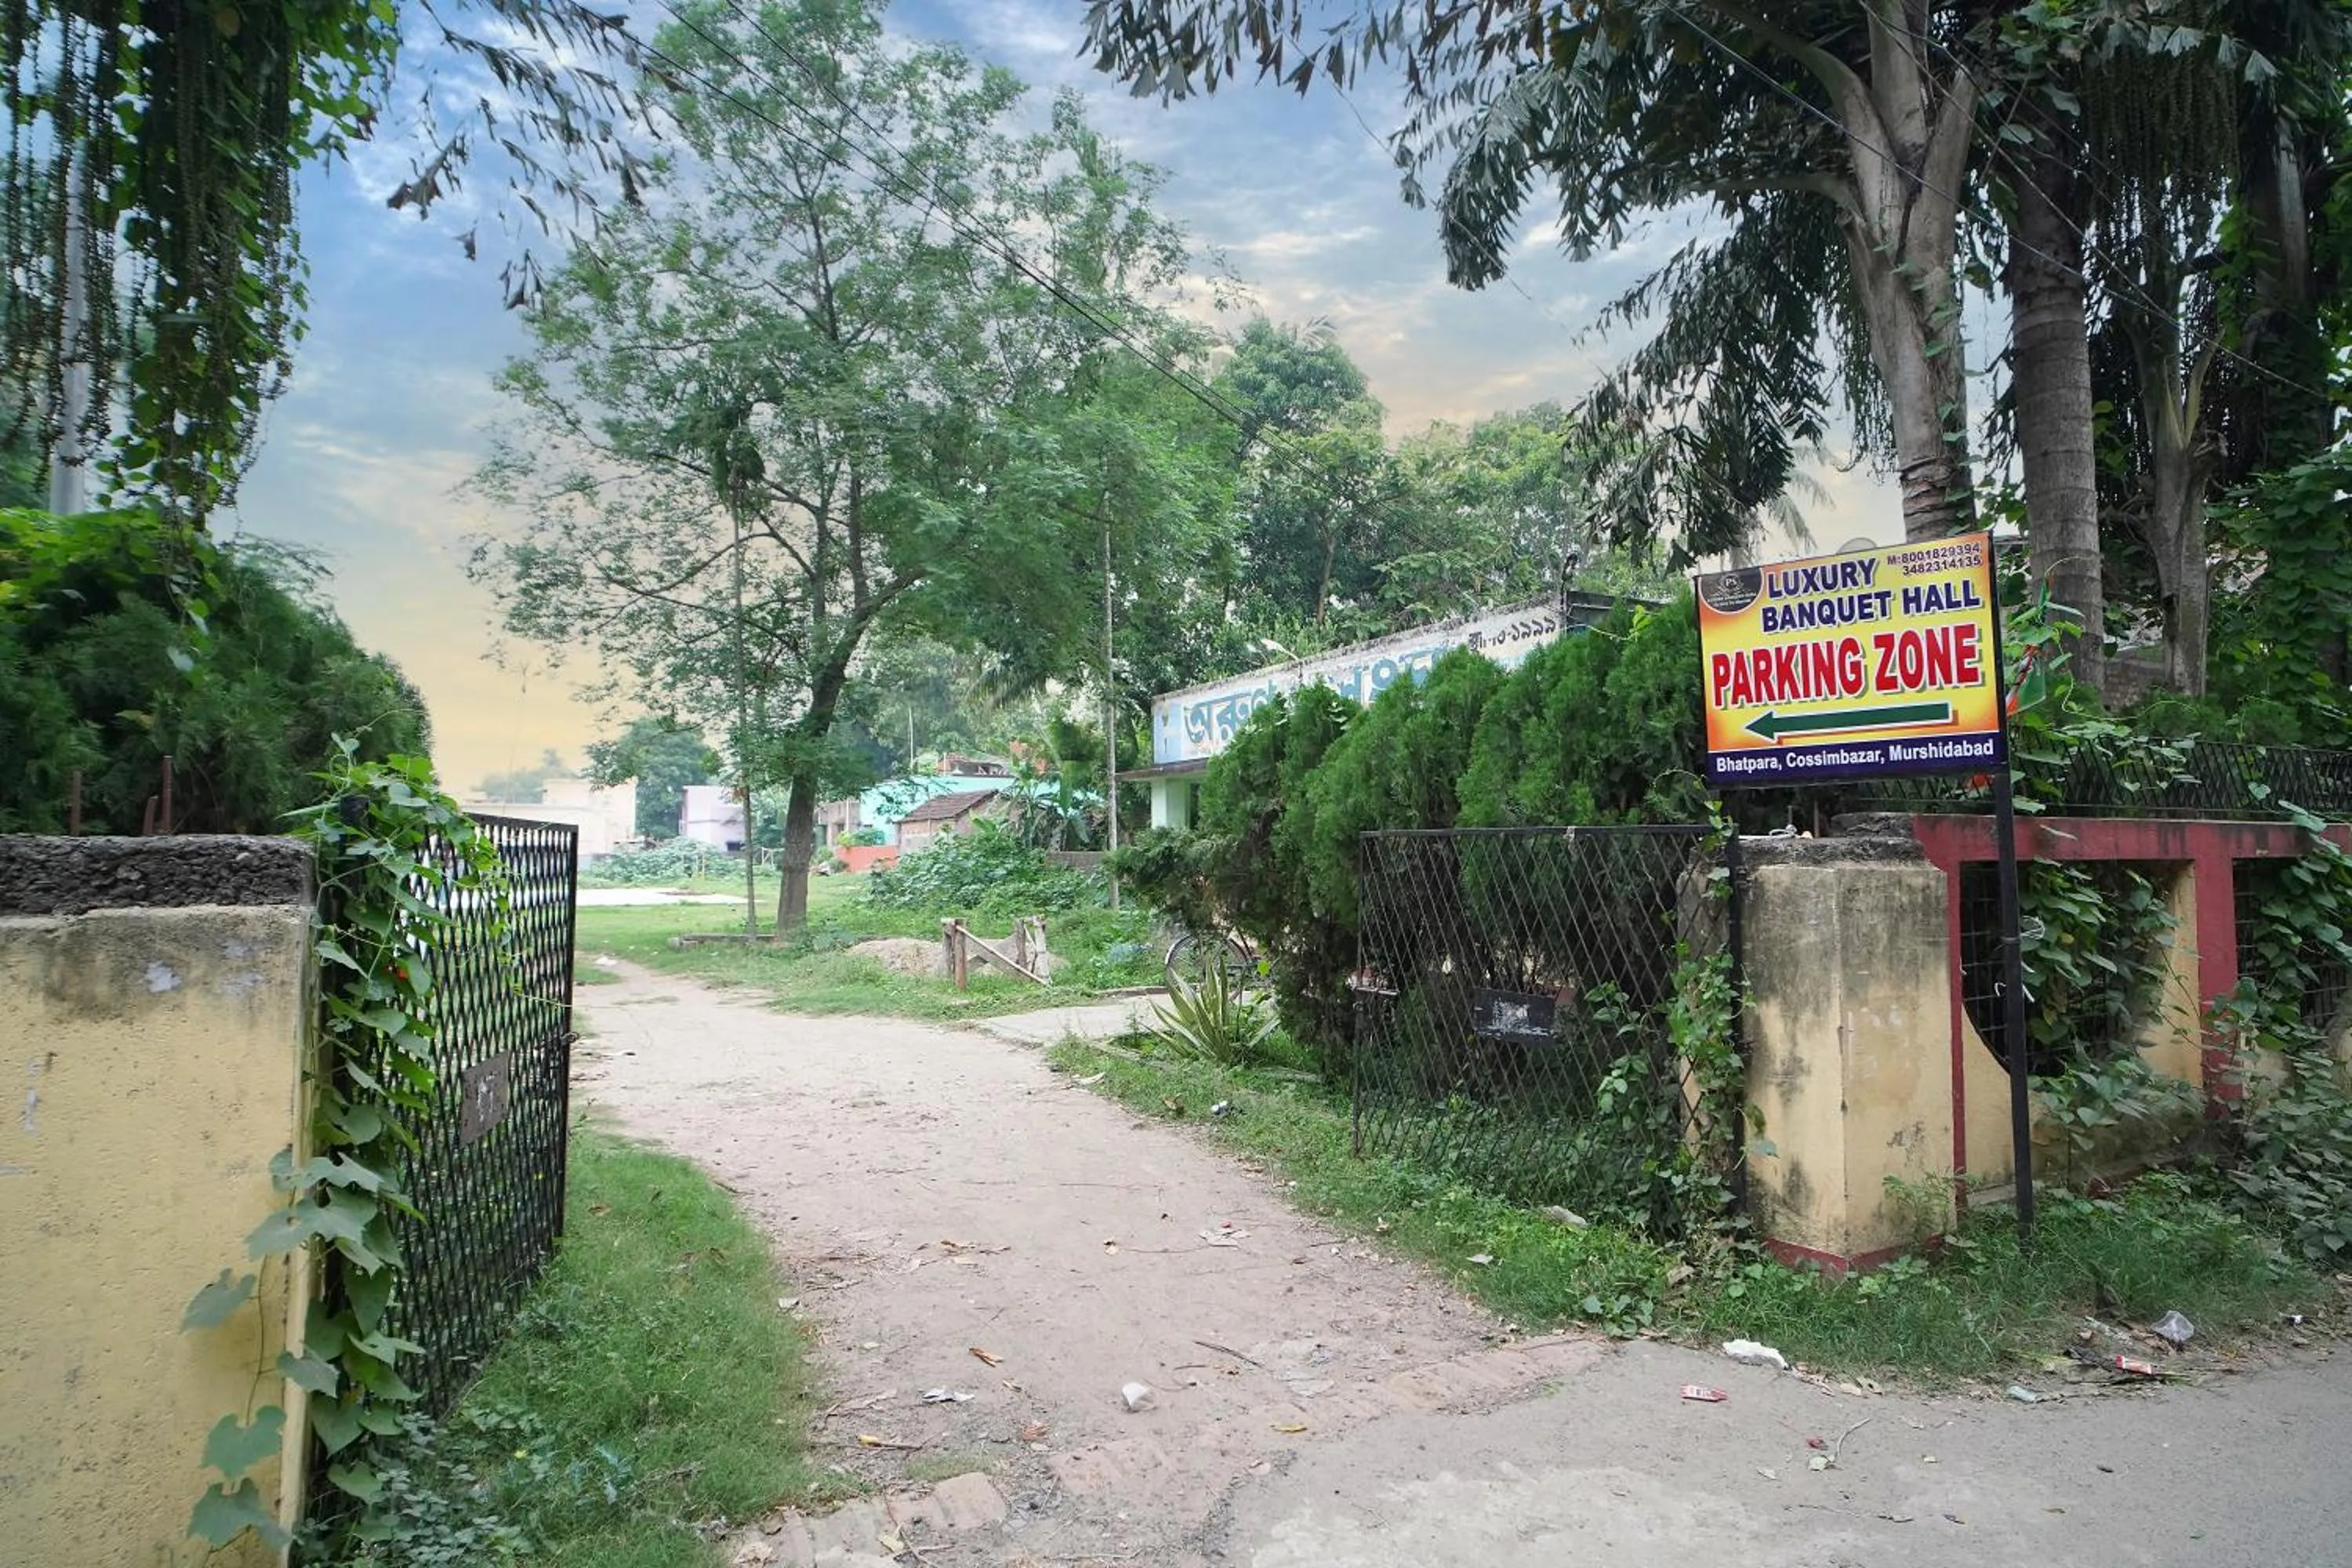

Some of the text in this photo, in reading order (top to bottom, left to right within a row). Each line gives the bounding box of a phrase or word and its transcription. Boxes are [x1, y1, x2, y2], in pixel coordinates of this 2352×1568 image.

[1768, 557, 1877, 598] LUXURY
[1762, 580, 1980, 633] BANQUET HALL
[1712, 623, 1979, 706] PARKING ZONE
[1716, 739, 1994, 773] Bhatpara, Cossimbazar, Murshidabad
